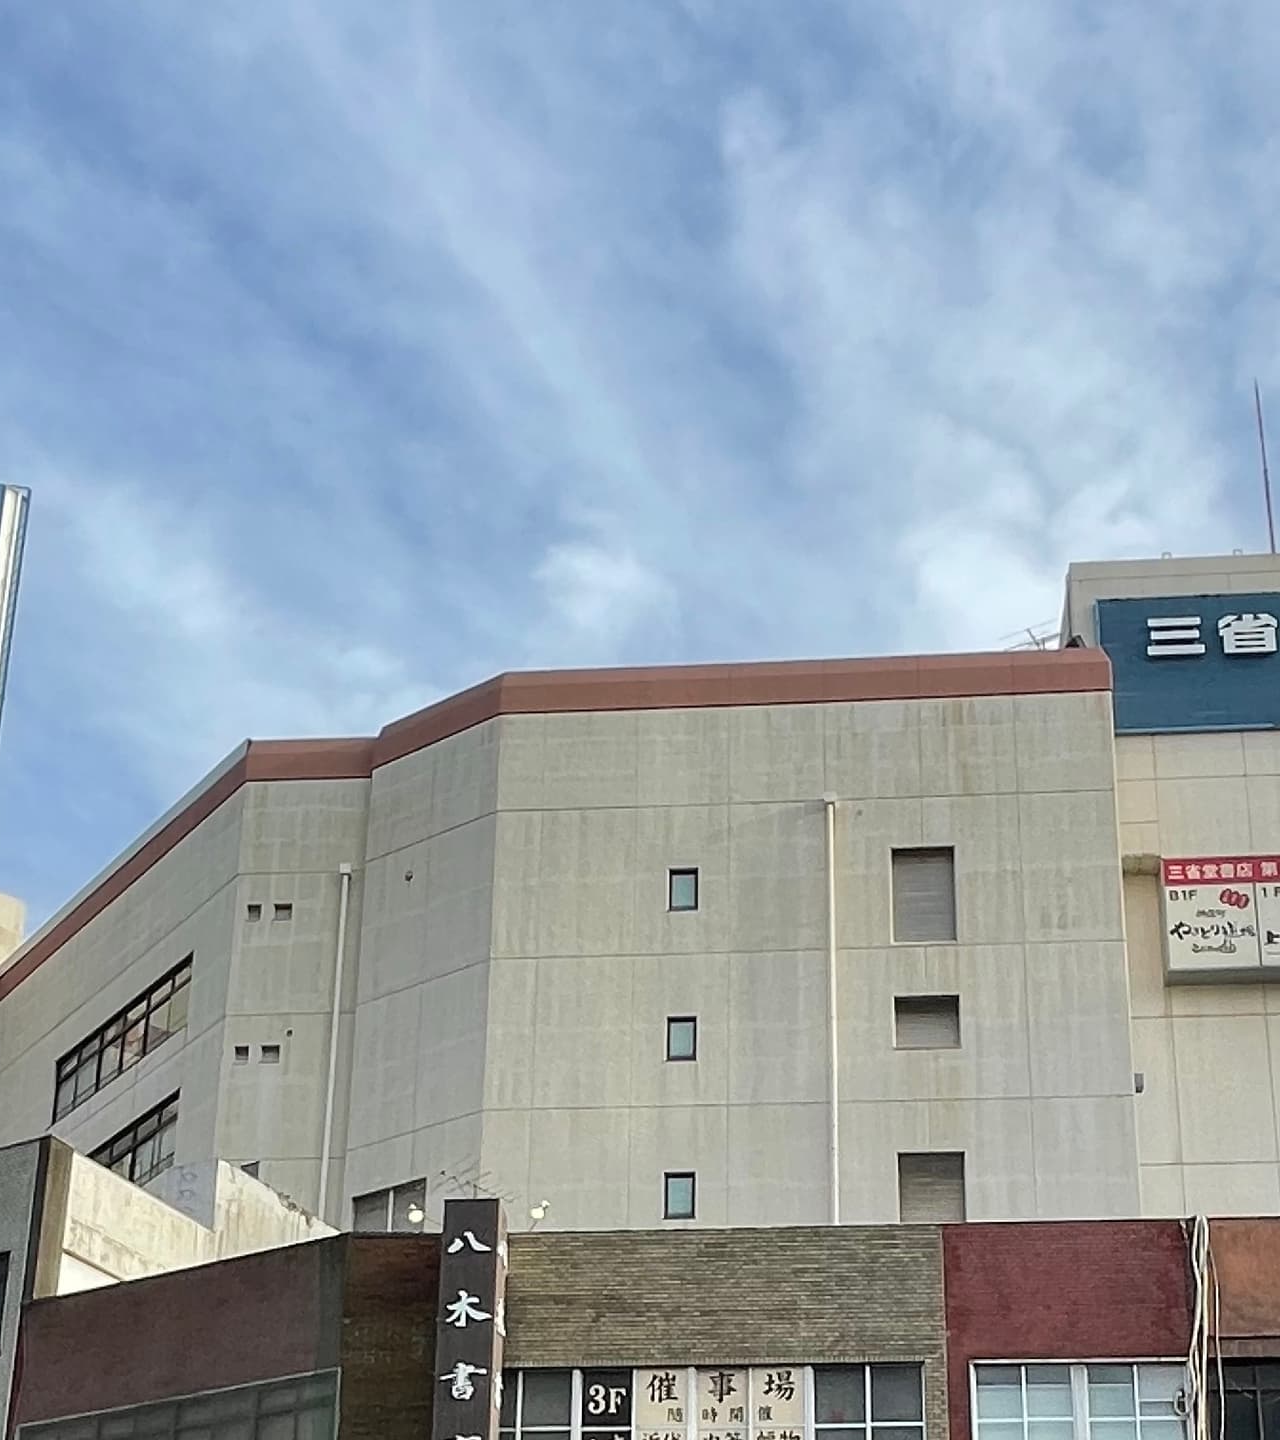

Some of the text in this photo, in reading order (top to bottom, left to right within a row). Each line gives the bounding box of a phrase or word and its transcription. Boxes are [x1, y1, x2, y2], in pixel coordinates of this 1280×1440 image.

[1168, 861, 1254, 881] 三省堂書店
[588, 1384, 627, 1416] 3F
[647, 1371, 796, 1404] 催事場
